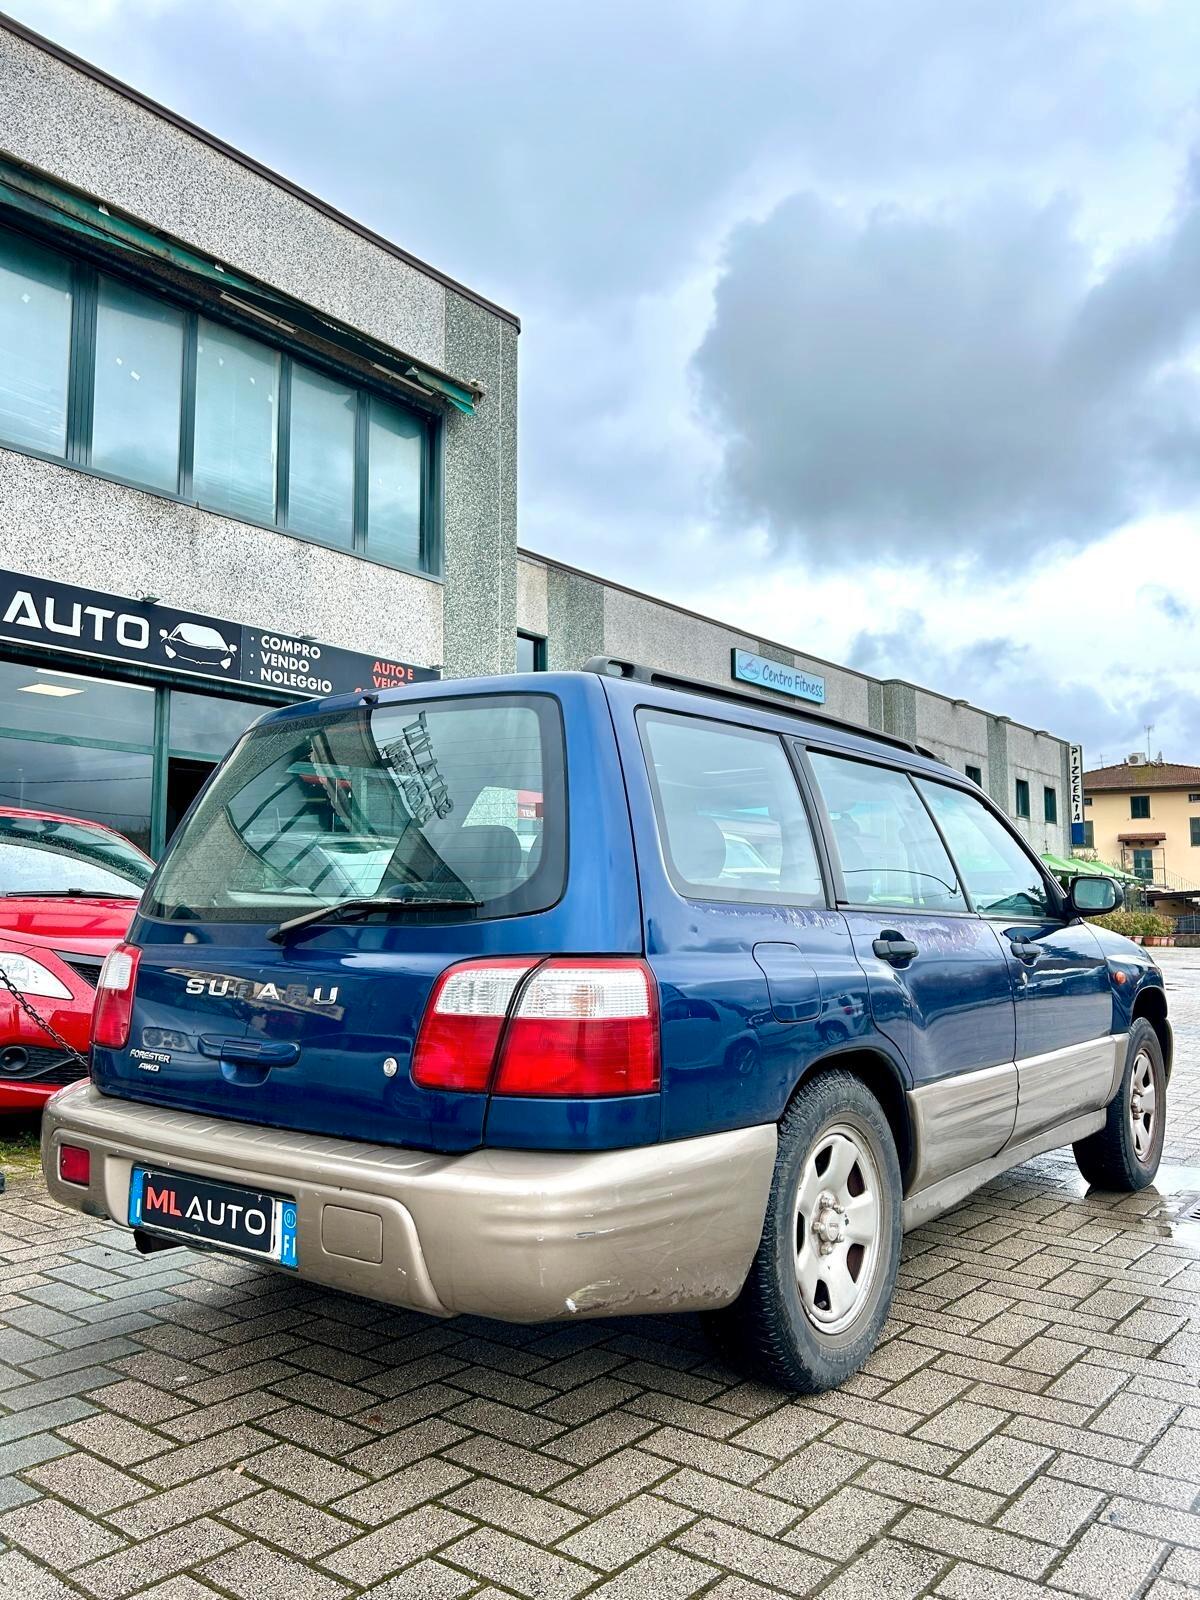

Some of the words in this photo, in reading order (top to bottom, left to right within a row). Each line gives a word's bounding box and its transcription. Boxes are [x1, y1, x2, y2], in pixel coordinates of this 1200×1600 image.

[2, 590, 150, 650] AUTO
[260, 635, 321, 659] COMPRO
[260, 651, 310, 673] VENDO
[372, 661, 405, 678] AUTO
[407, 668, 414, 680] E
[260, 668, 333, 694] NOLEGGIO
[762, 665, 792, 688] Centro
[795, 675, 823, 697] Fitness
[1071, 747, 1081, 822] PIZZERIA
[185, 978, 338, 1005] SUAU
[130, 1049, 170, 1063] FORESTER
[138, 1062, 160, 1072] AWD
[283, 1234, 296, 1258] FI
